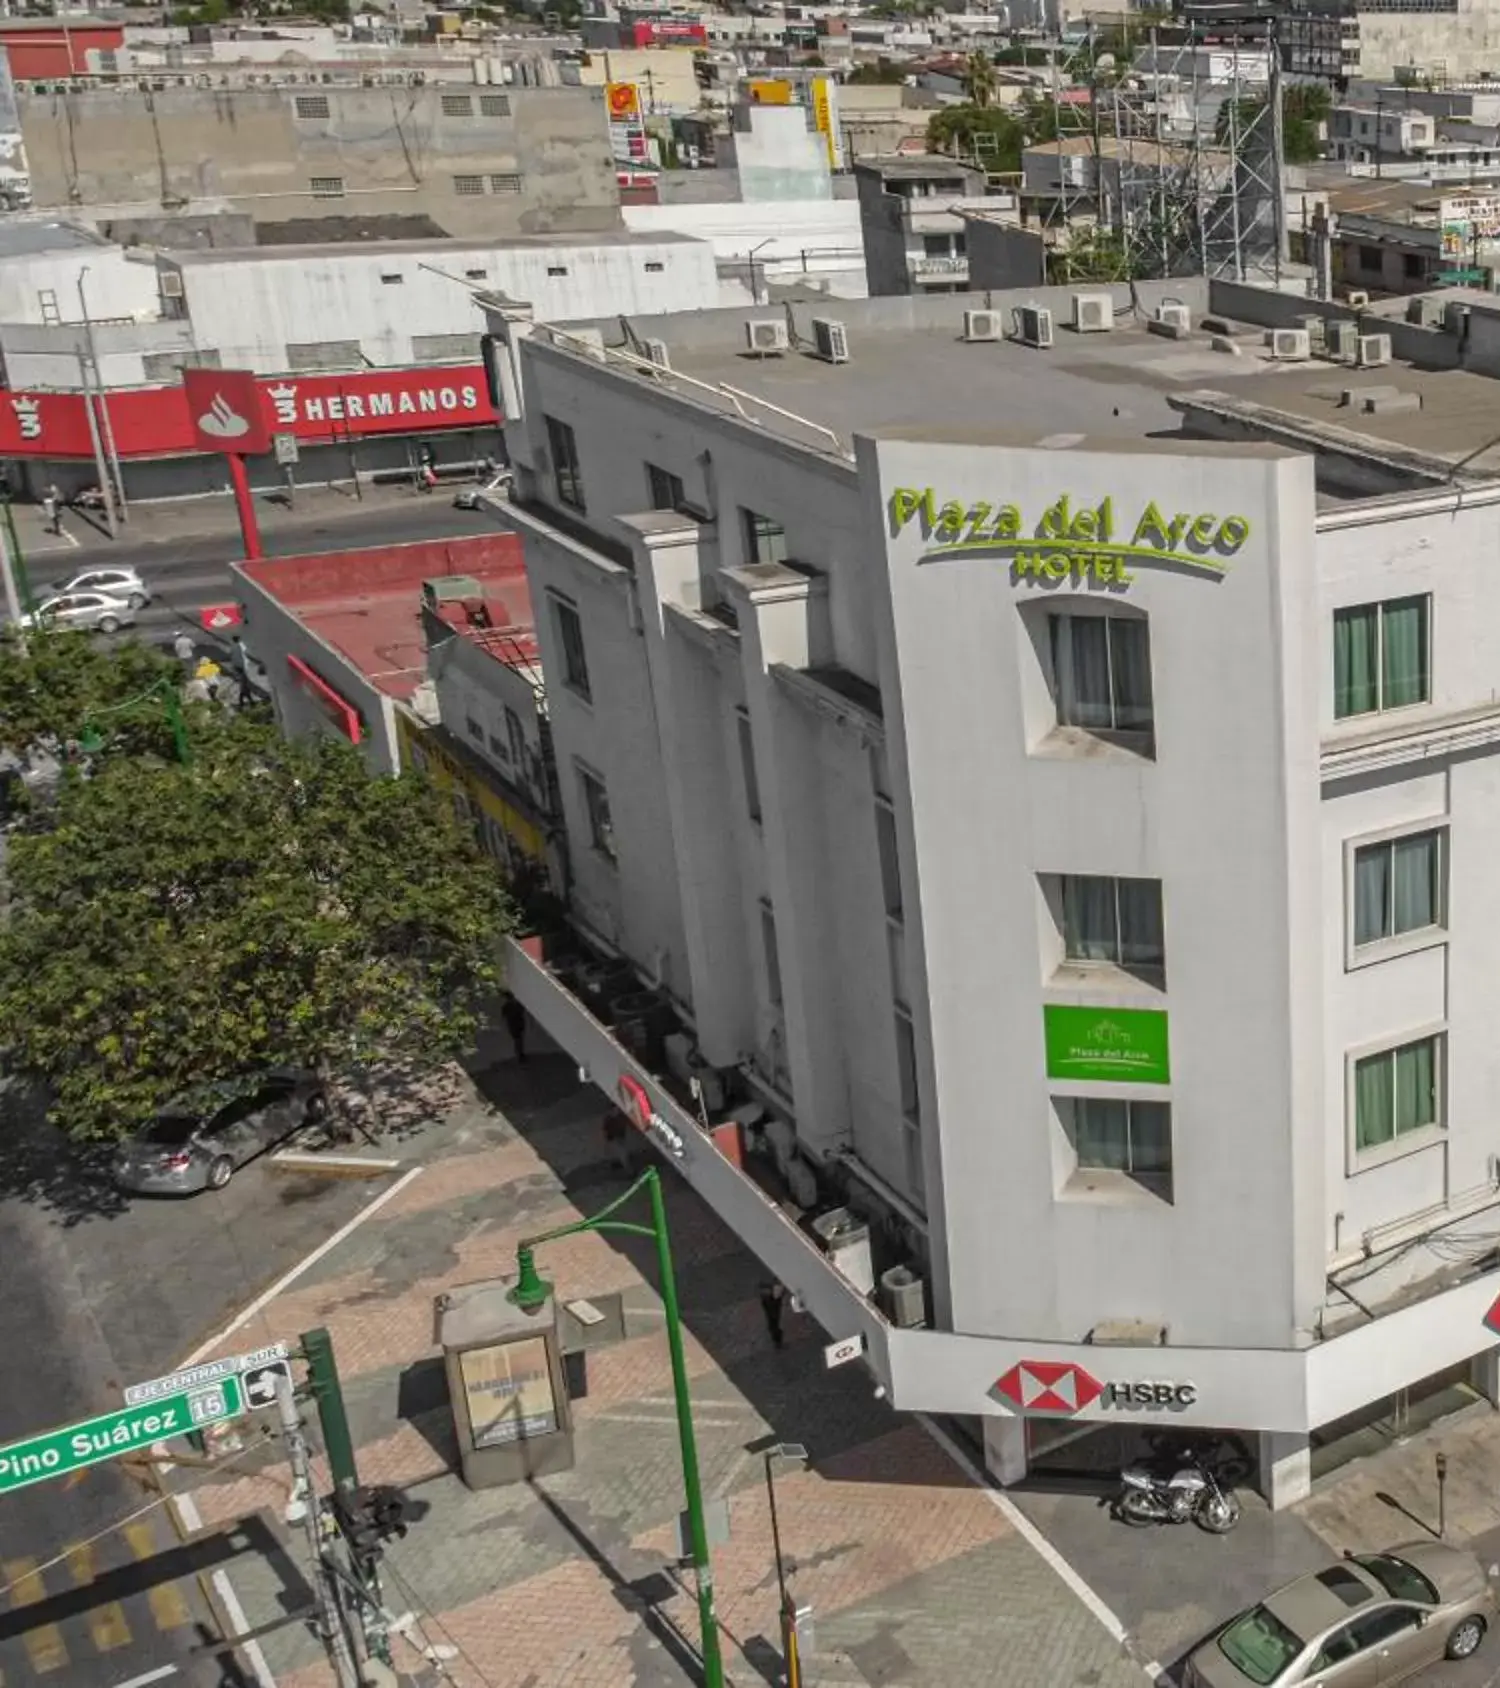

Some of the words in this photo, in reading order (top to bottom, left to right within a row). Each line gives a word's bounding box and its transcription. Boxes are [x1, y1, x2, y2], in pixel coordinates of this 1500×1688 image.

[305, 383, 477, 421] HERMANOS
[892, 486, 1022, 536] Plaza
[1041, 493, 1115, 539] del
[1134, 501, 1251, 545] Arco
[1014, 552, 1136, 584] HOTEL
[161, 1363, 228, 1391] CENTRAL
[246, 1347, 279, 1364] SUR
[1110, 1382, 1197, 1406] HSBC
[70, 1408, 178, 1458] Suárez
[191, 1399, 222, 1421] 15
